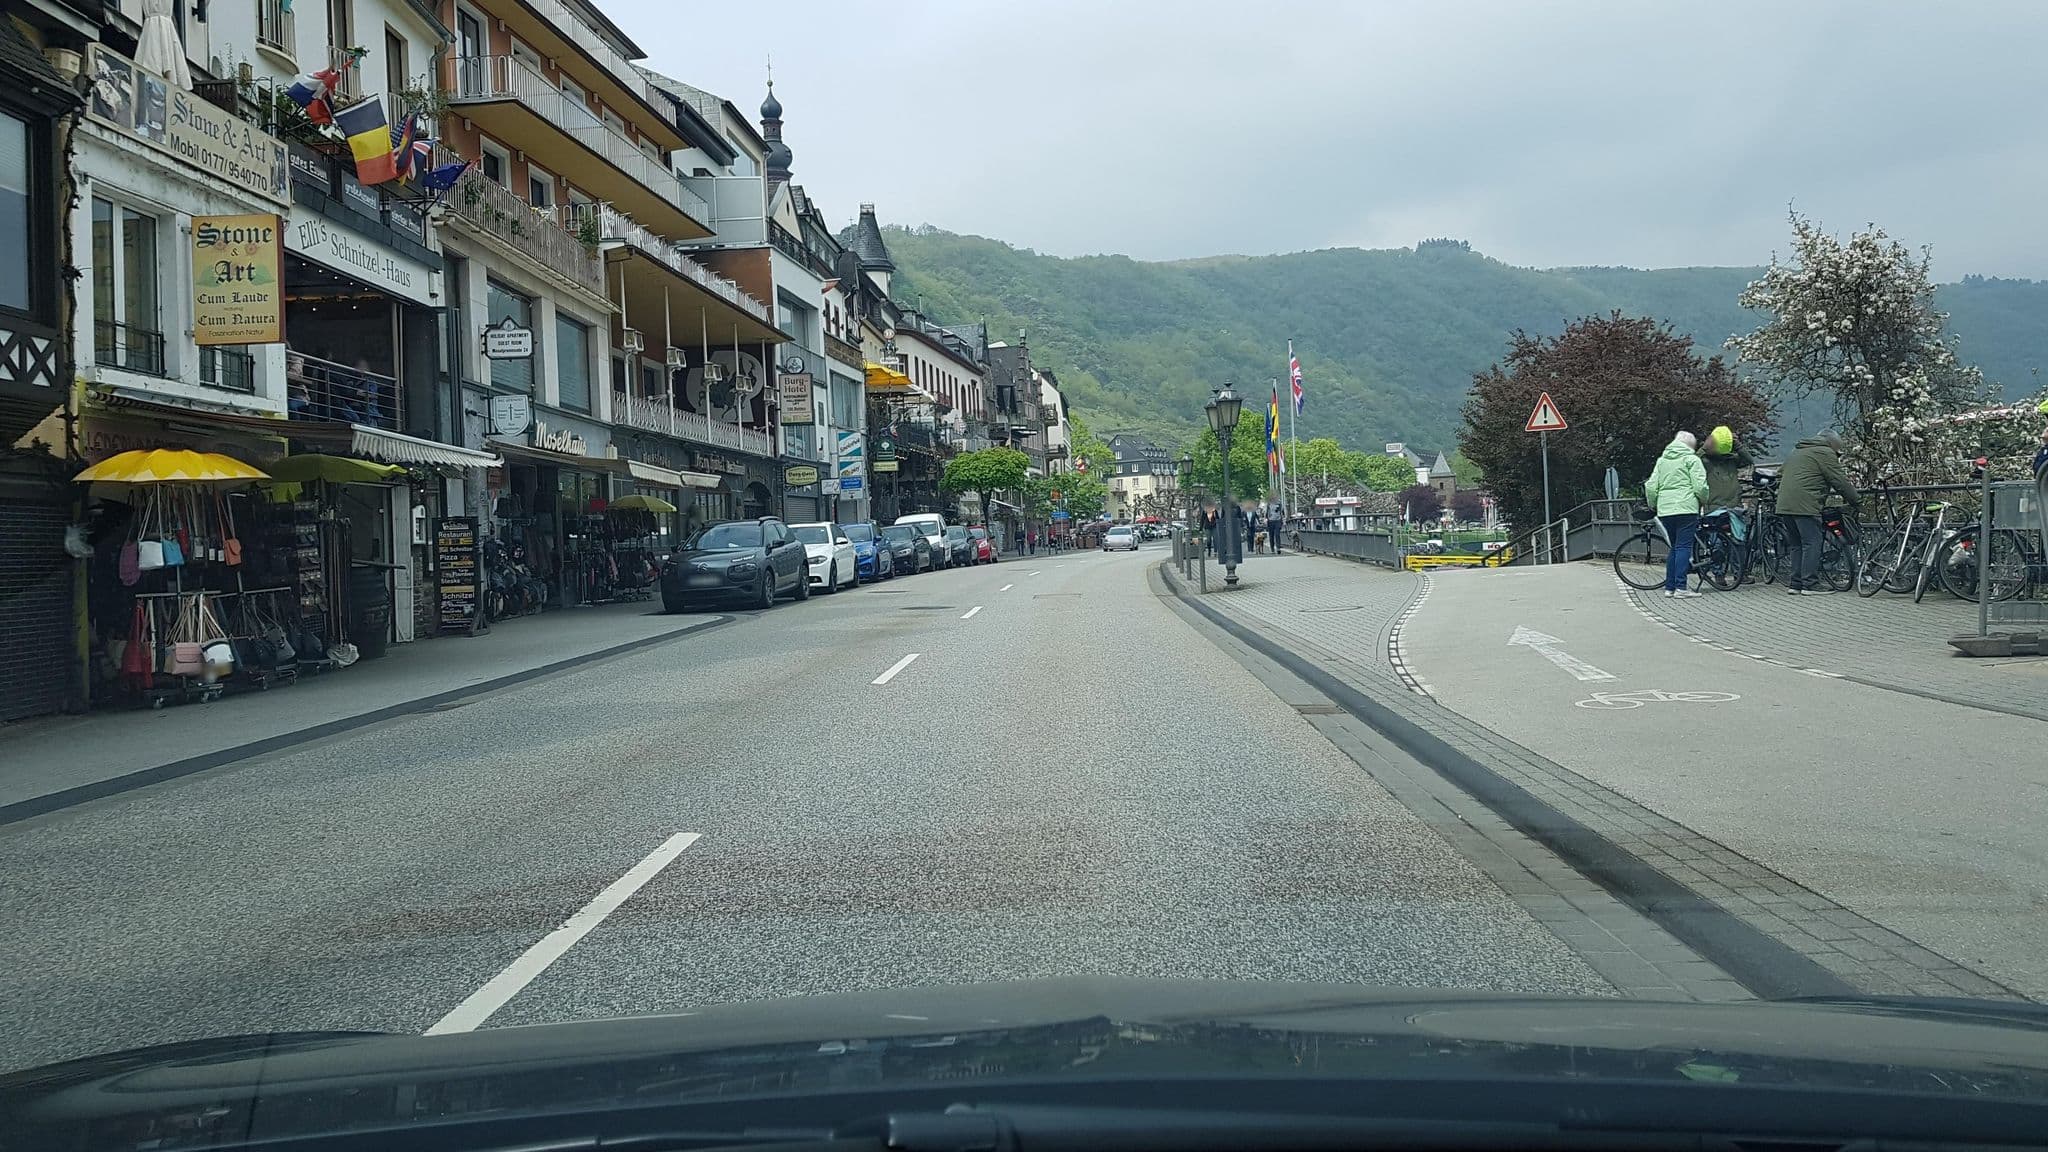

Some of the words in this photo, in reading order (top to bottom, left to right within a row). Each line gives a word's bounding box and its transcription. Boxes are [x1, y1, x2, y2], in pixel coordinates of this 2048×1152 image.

[170, 91, 220, 140] Stone
[223, 119, 237, 149] &
[240, 128, 266, 163] Art
[170, 132, 199, 161] Mobil
[196, 222, 273, 249] Stone
[230, 247, 240, 257] &
[214, 260, 256, 284] Art
[197, 293, 226, 305] Cum
[231, 291, 269, 304] Laude
[197, 315, 226, 326] Cum
[231, 313, 276, 325] Natura
[784, 377, 809, 386] Burg-
[784, 385, 807, 393] Hotel
[534, 419, 587, 456] Moselhaus
[442, 592, 475, 600] Schnitzel
